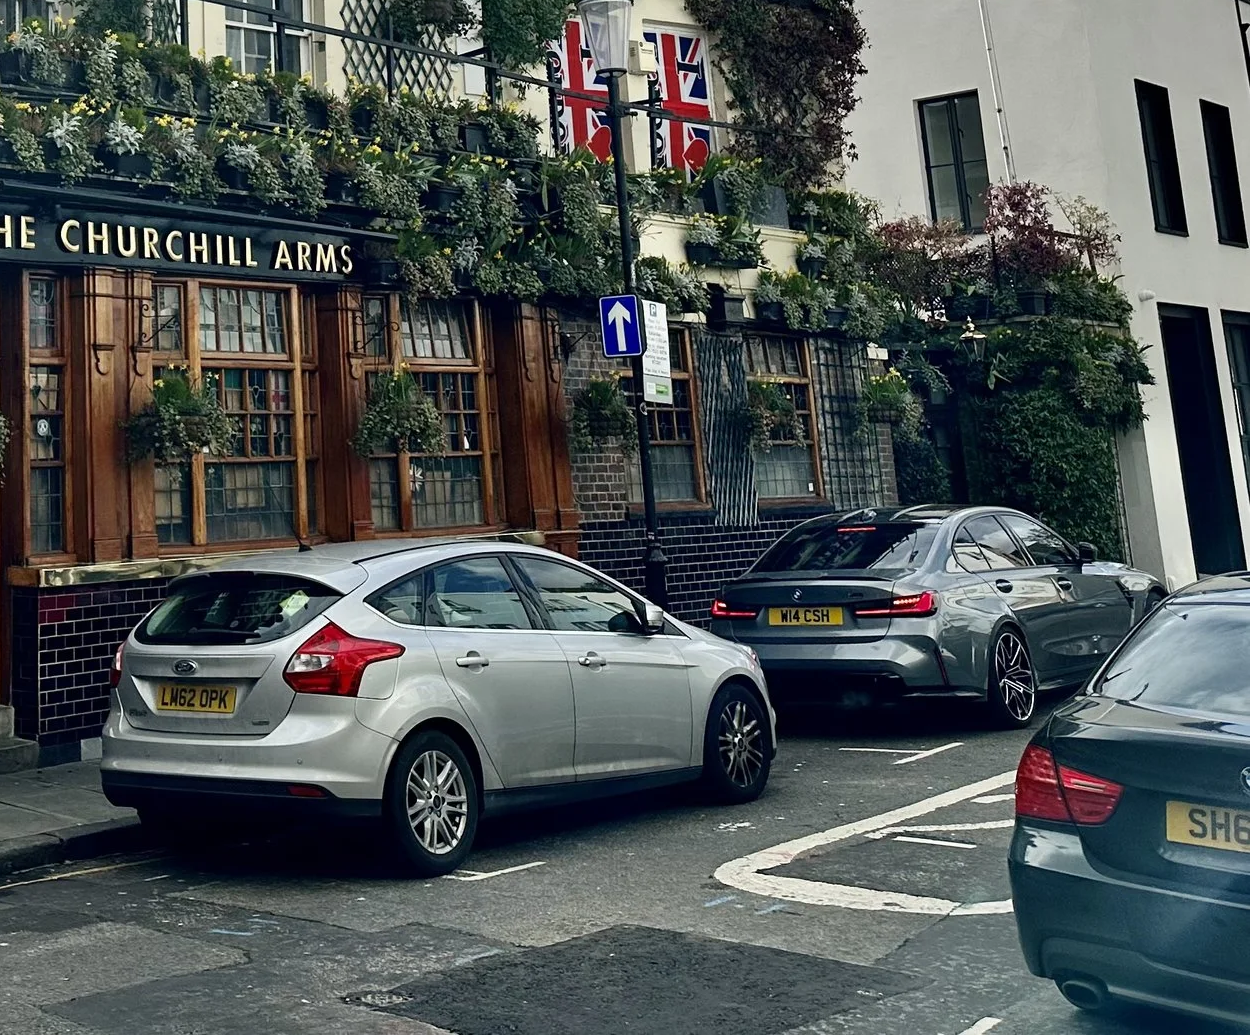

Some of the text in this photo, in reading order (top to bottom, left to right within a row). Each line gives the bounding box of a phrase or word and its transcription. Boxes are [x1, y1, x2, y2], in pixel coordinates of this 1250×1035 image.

[59, 218, 258, 267] CHURCHILL
[273, 239, 354, 275] ARMS
[804, 608, 830, 623] CSH
[161, 687, 230, 710] LM62 OPK
